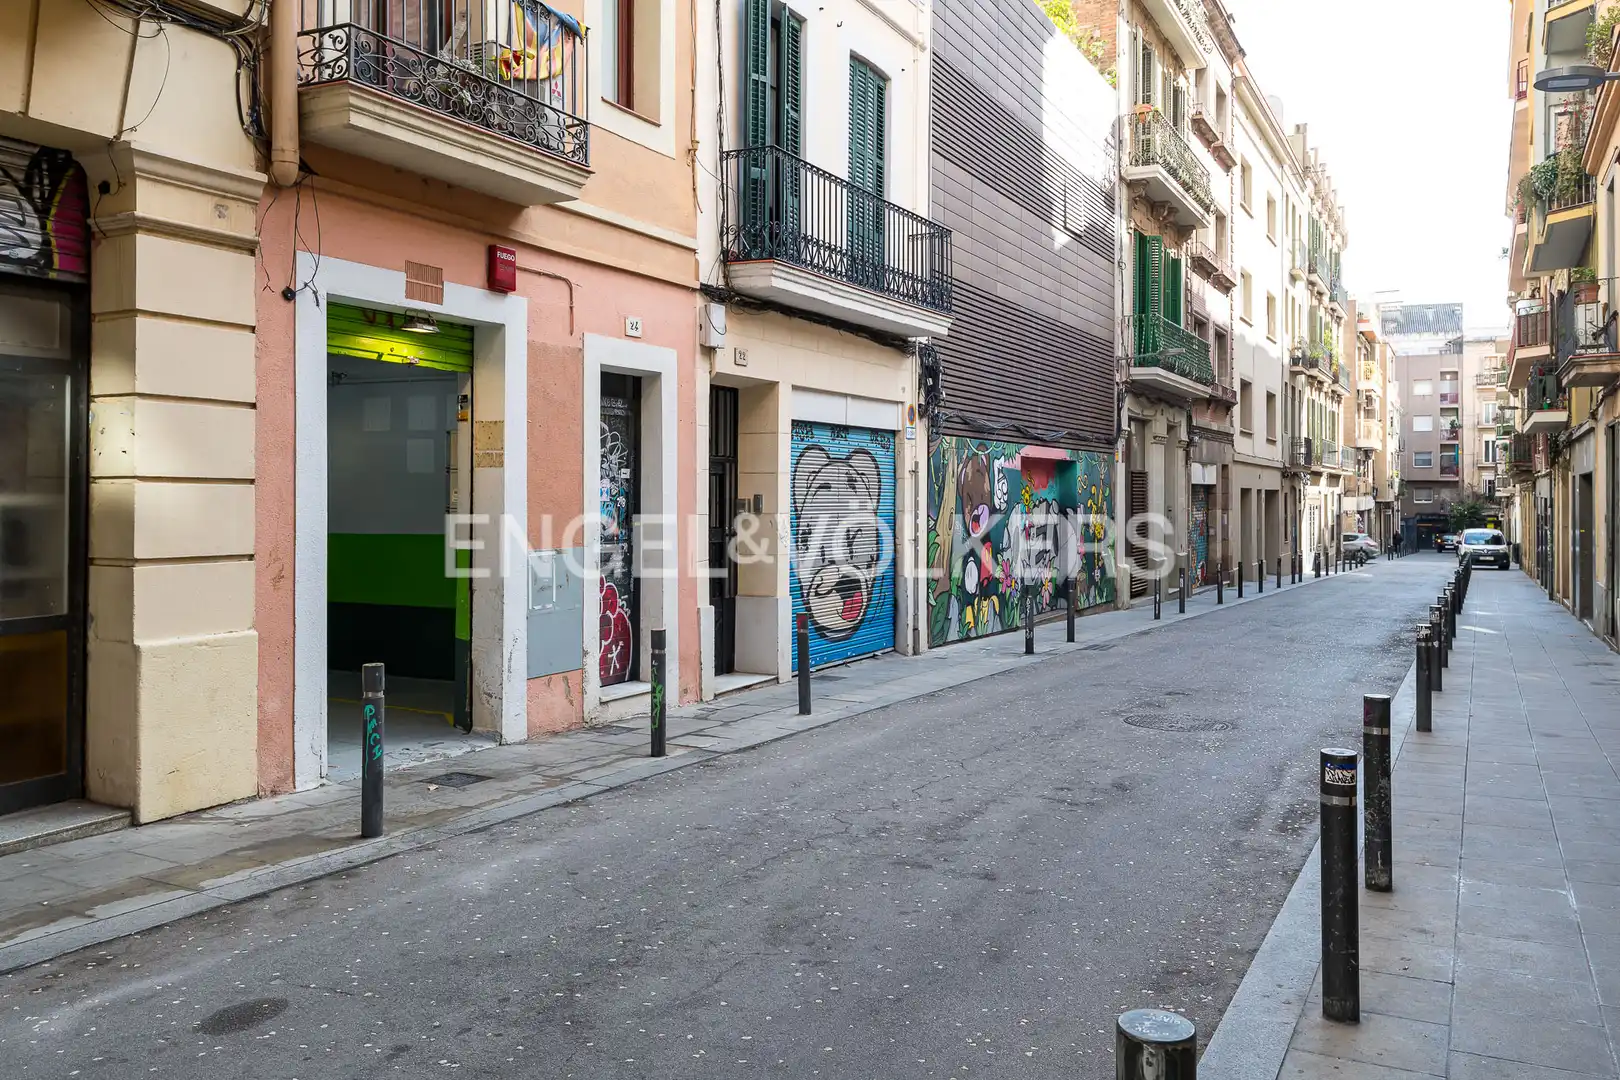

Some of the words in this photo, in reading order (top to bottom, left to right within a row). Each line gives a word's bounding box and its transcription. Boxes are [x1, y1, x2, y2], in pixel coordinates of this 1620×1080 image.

[496, 251, 516, 262] FUEGO
[629, 320, 640, 332] 24
[738, 350, 746, 361] 22
